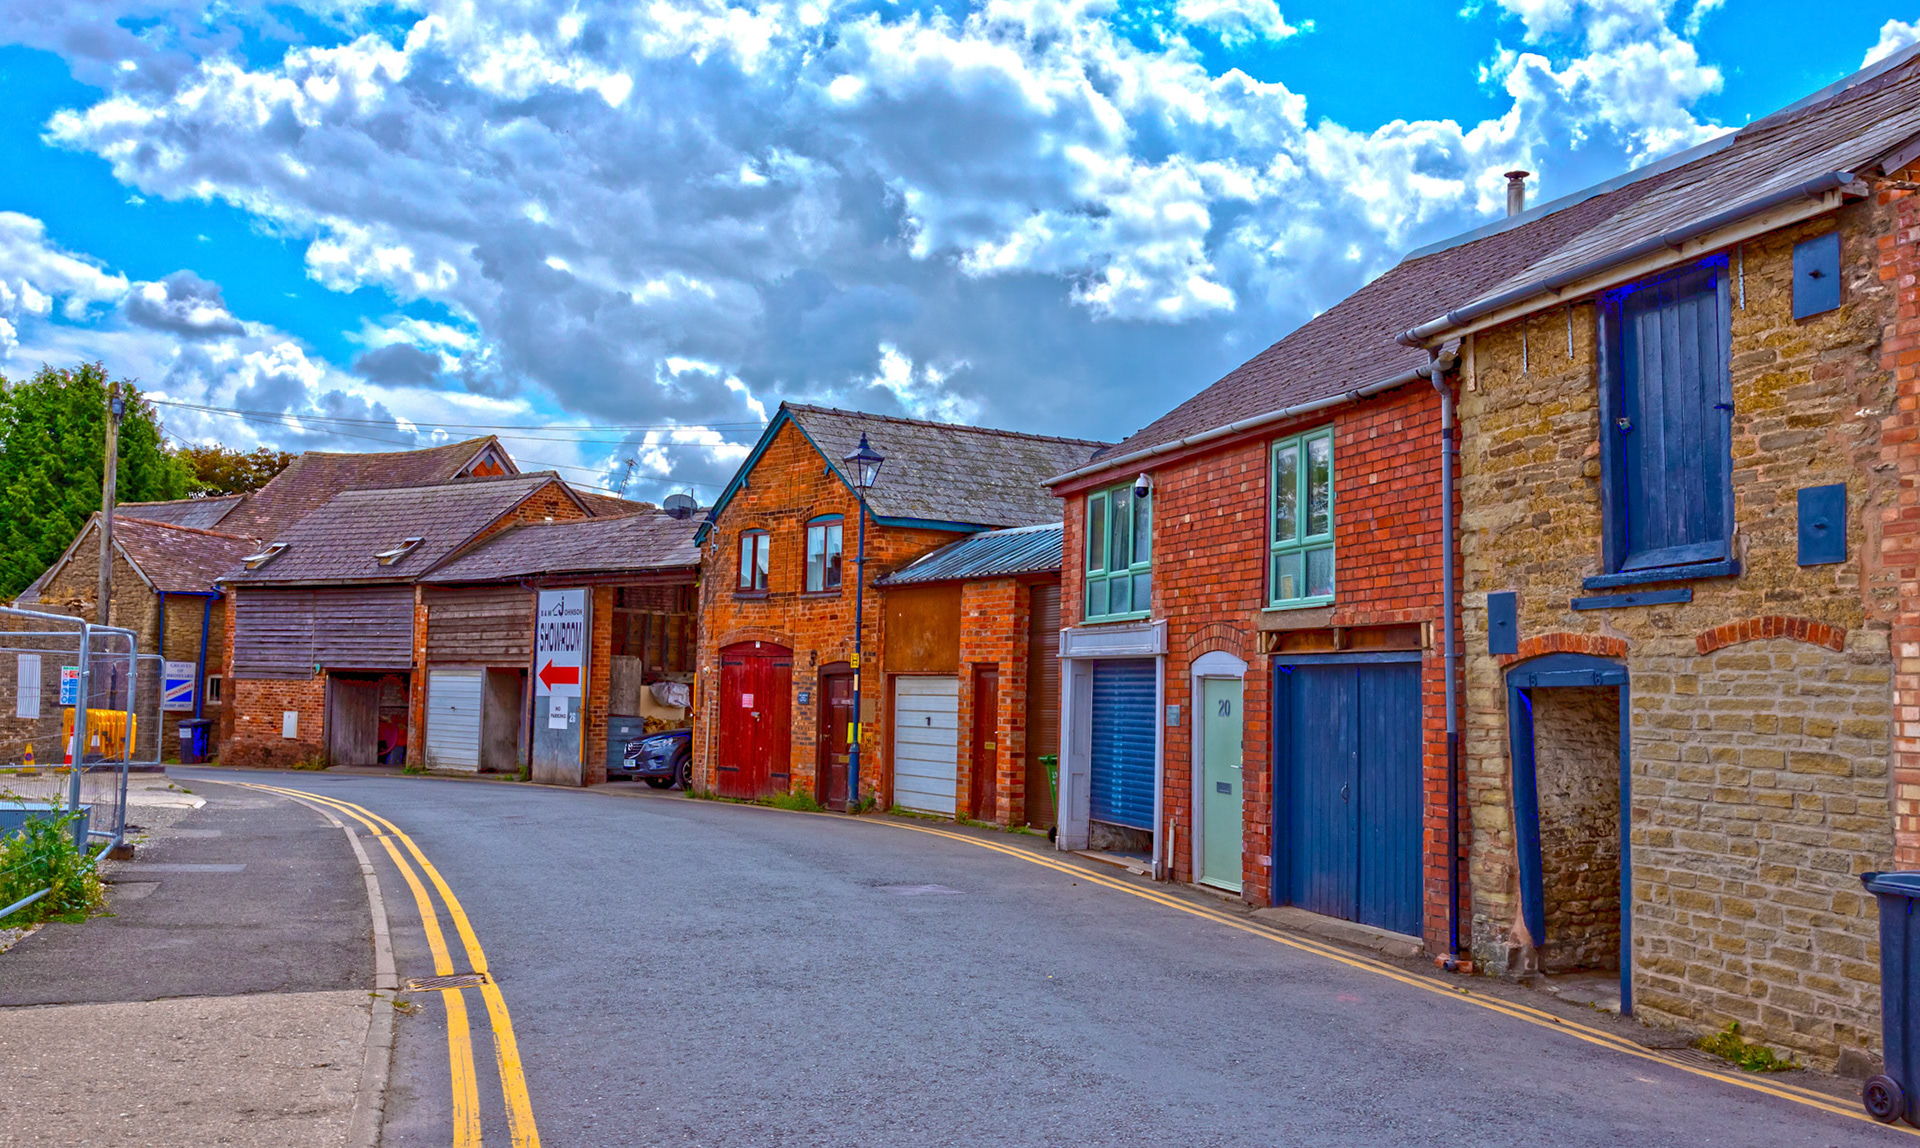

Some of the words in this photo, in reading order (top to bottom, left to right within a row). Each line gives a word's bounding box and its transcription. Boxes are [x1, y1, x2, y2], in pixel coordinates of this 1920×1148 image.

[540, 622, 582, 652] SHOWROOM
[1218, 699, 1231, 717] 20
[569, 712, 576, 723] 26
